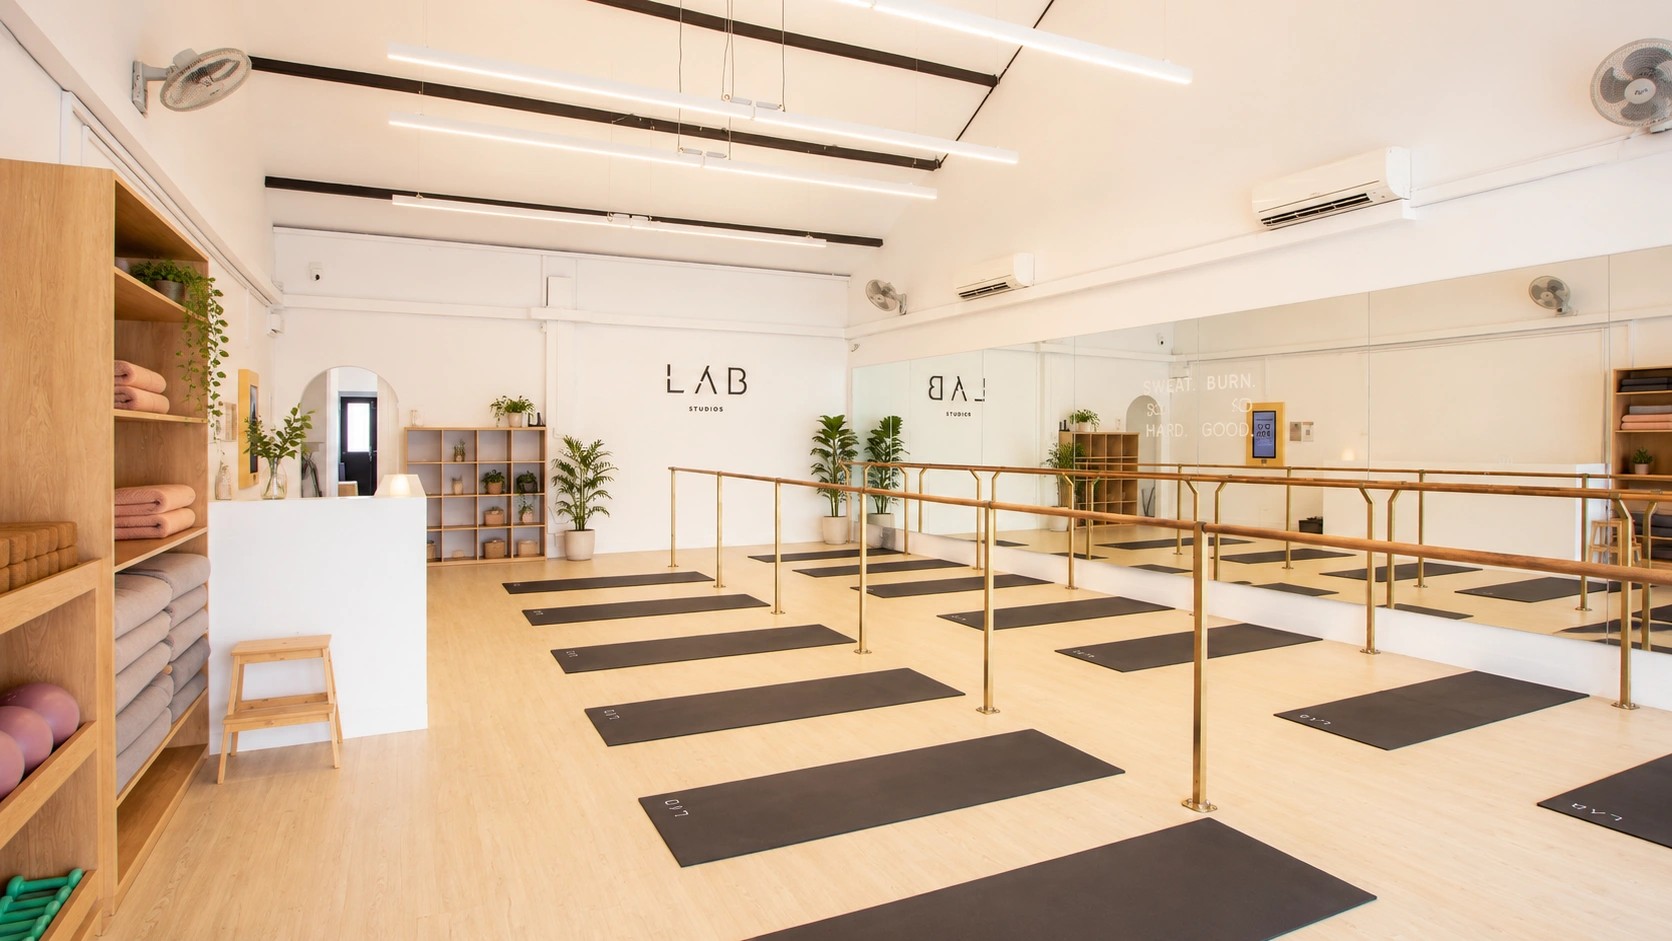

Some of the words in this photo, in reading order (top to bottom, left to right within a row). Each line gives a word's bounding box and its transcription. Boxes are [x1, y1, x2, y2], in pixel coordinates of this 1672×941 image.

[666, 363, 748, 395] LAB
[1143, 377, 1196, 396] SWEAT.
[1206, 373, 1256, 391] BURN.
[688, 405, 724, 413] STUDIOS
[1145, 422, 1188, 438] HARD.
[1201, 421, 1255, 438] GOOD.
